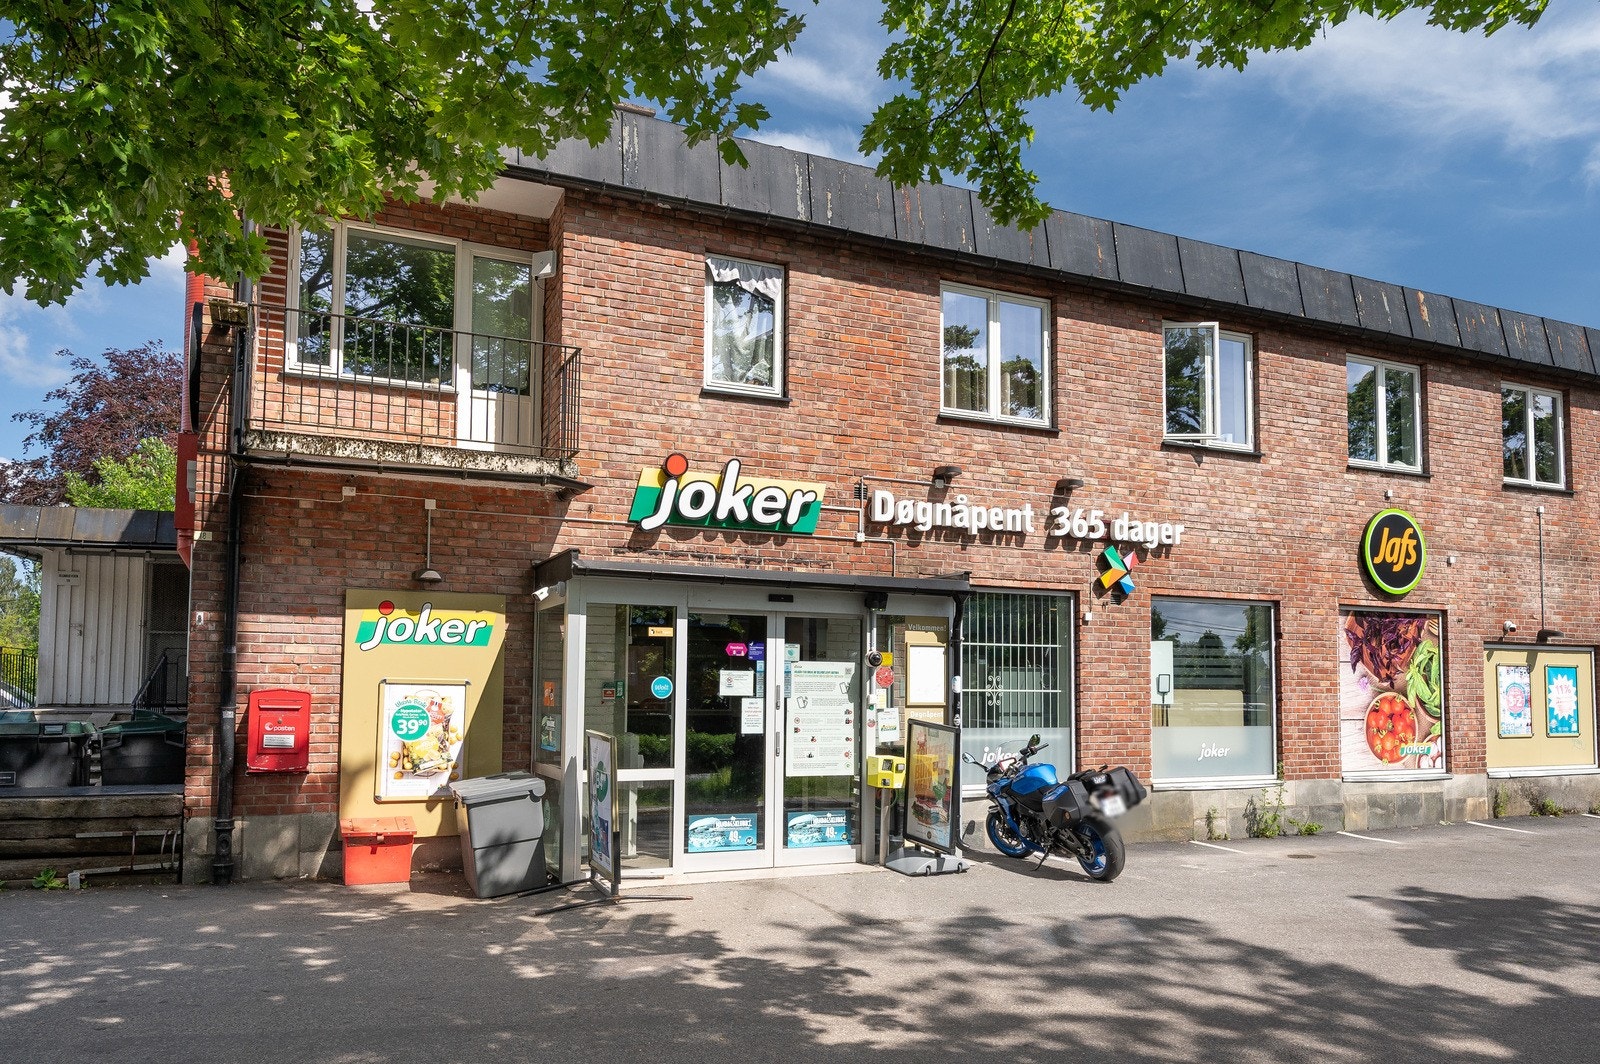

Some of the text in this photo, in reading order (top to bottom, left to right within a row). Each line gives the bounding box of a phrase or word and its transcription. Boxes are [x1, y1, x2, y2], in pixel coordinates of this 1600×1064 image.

[639, 452, 818, 531] joker
[871, 489, 1186, 549] Døgnåpent 365 dager
[1373, 527, 1417, 572] Jafs
[360, 600, 487, 651] joker
[908, 623, 947, 632] Velkommen!
[910, 711, 944, 719] Døgnåpent
[396, 719, 419, 735] 39
[1197, 742, 1231, 762] joker
[1400, 742, 1431, 757] joker
